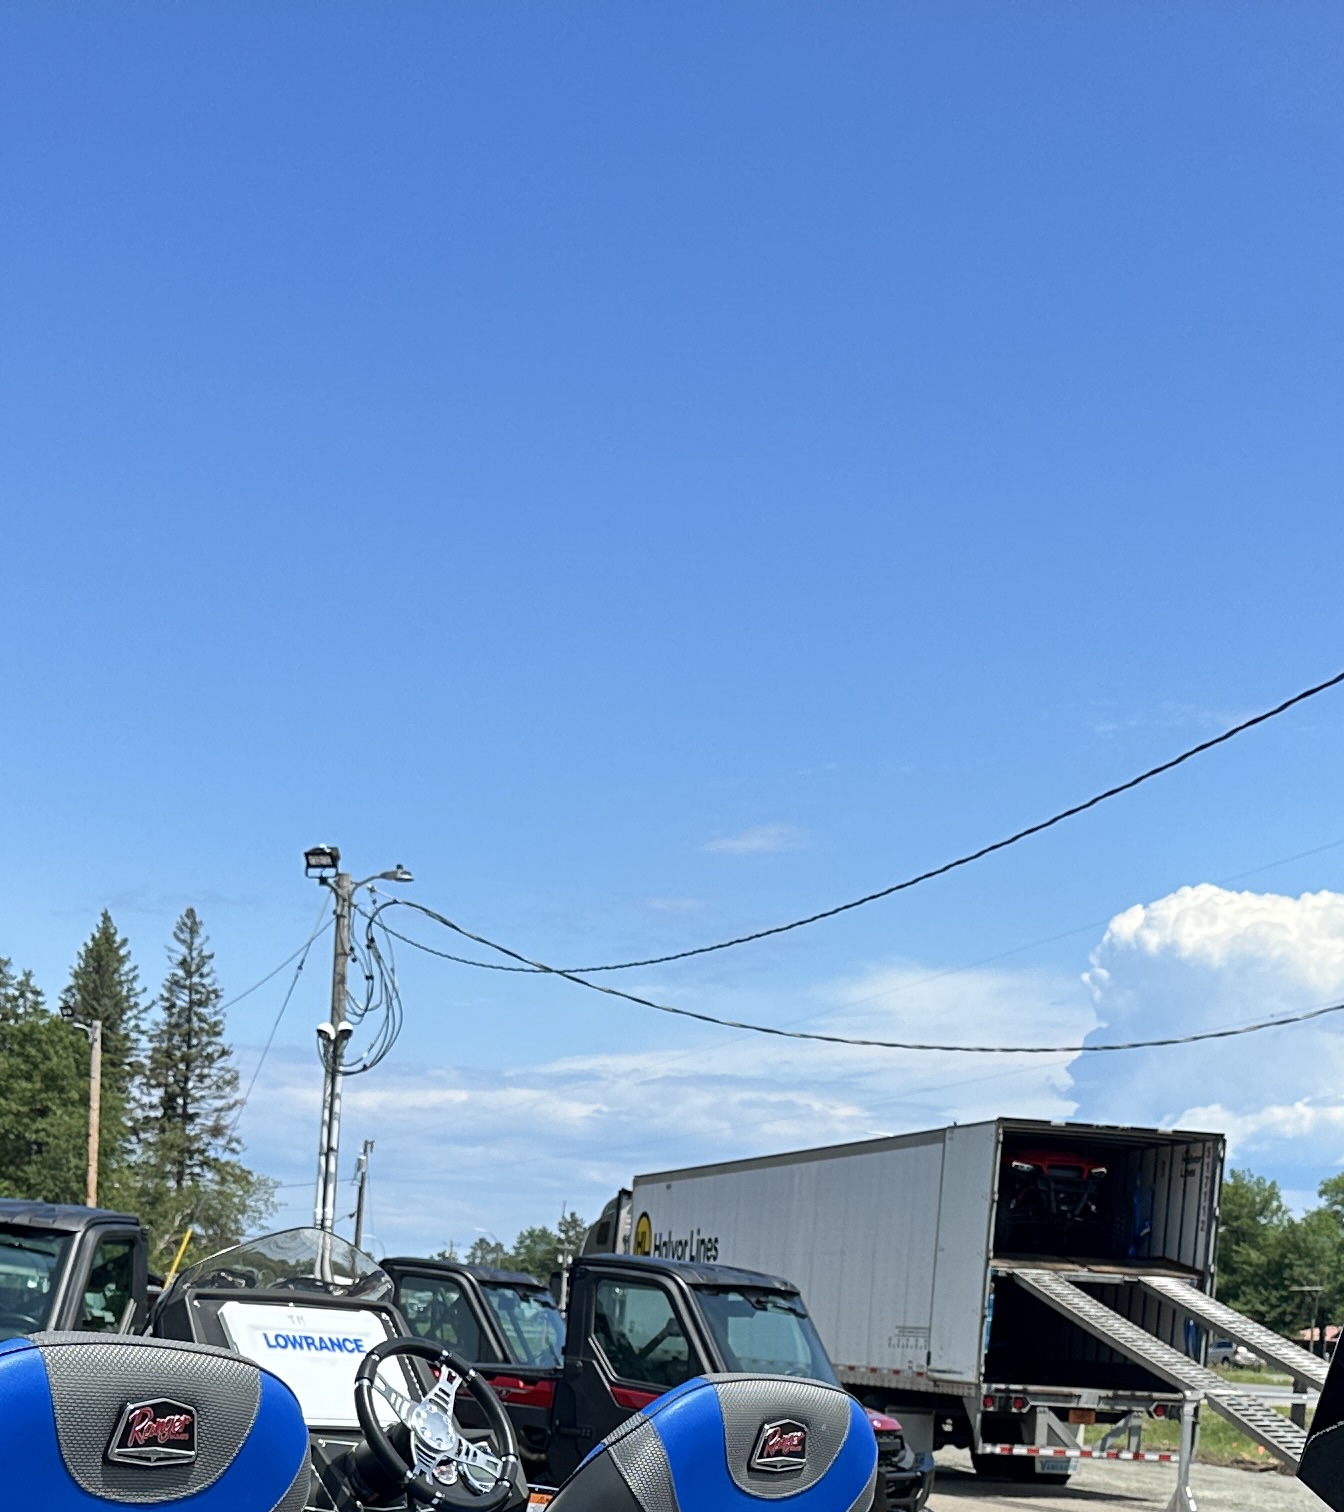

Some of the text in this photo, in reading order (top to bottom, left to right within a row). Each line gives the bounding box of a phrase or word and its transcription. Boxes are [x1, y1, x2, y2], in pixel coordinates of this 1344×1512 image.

[654, 1228, 719, 1263] Halvor Lines
[262, 1332, 367, 1354] LOWRANCE
[128, 1407, 194, 1447] Ranger
